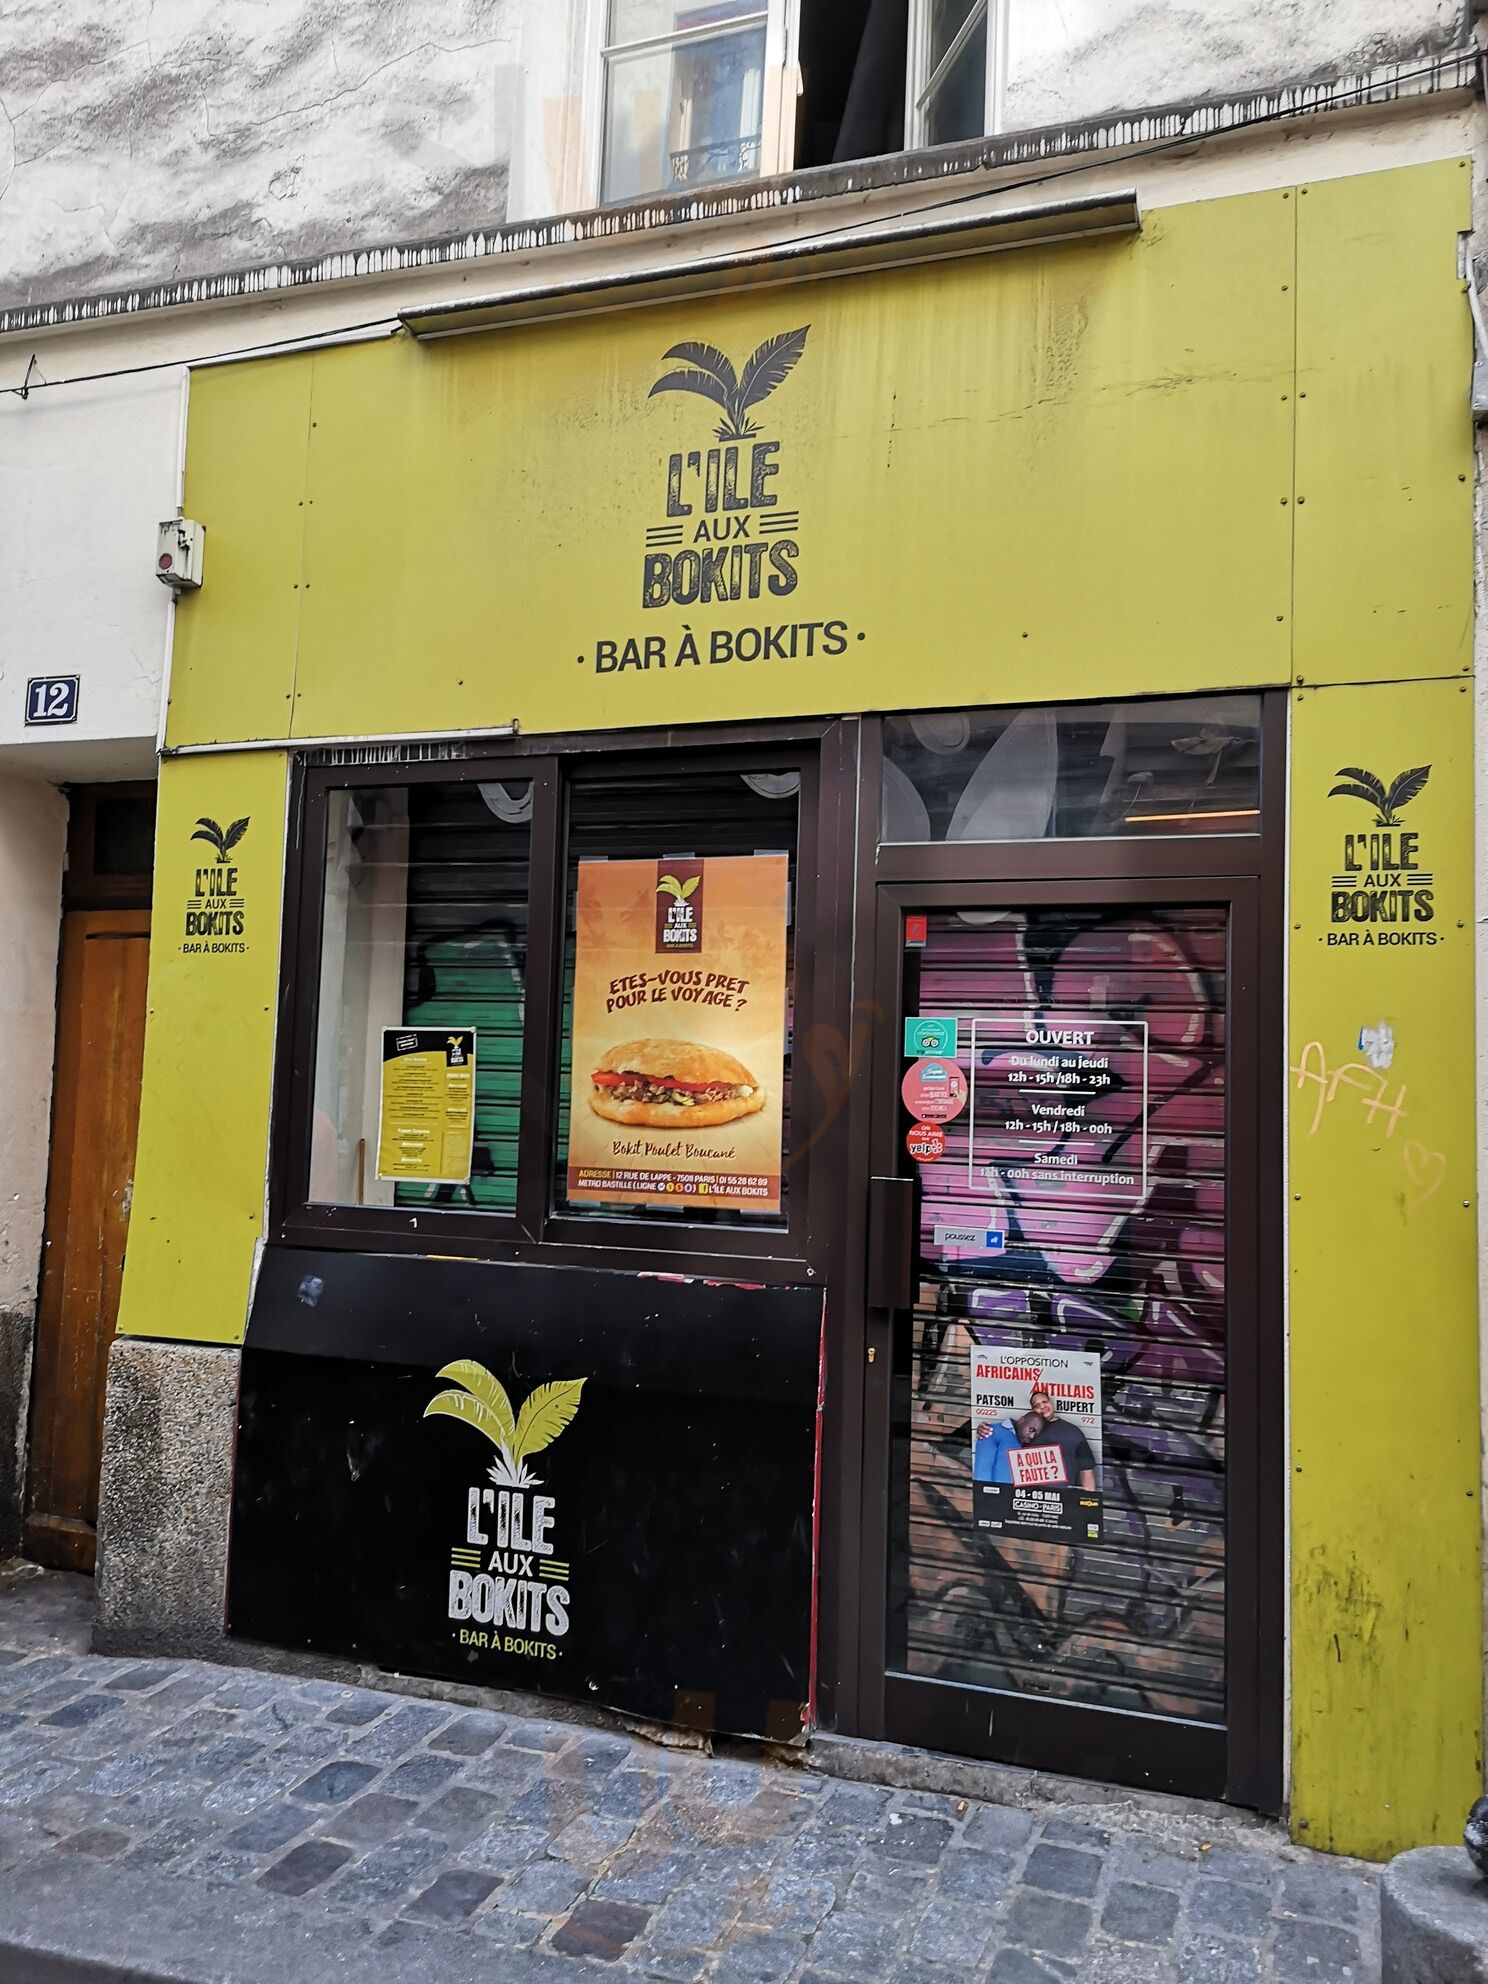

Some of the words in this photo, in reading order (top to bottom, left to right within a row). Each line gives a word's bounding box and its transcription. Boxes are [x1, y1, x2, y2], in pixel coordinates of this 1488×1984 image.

[666, 440, 780, 518] L'ILE
[693, 514, 750, 543] AUX
[642, 539, 799, 609] BOKITS
[595, 636, 666, 673] BAR
[674, 624, 700, 667] À
[710, 620, 847, 664] BOKITS
[32, 682, 69, 718] 12
[1344, 832, 1419, 872] L'ILE
[195, 867, 237, 898] L'ILE
[1363, 874, 1401, 888] AUX
[205, 898, 227, 909] AUX
[1331, 889, 1434, 924] BOKITS
[185, 911, 244, 936] BOKITS
[182, 943, 202, 954] BAR
[202, 940, 212, 954] À
[212, 942, 245, 954] BOKITS
[1327, 931, 1360, 947] BAR
[1362, 928, 1375, 946] À
[1378, 930, 1438, 946] BOKITS
[609, 970, 703, 995] ETES-VOUS
[705, 972, 750, 994] PRET
[606, 990, 647, 1014] POUR
[651, 987, 668, 1003] LE
[671, 986, 734, 1007] VOYAGE
[1025, 1030, 1095, 1046] OUVERT
[1029, 1056, 1059, 1067] lundi
[1061, 1058, 1076, 1067] au
[1078, 1057, 1109, 1069] jeudi
[1007, 1072, 1026, 1083] 12h
[1036, 1073, 1055, 1085] 15h
[1089, 1074, 1111, 1087] 23h
[1031, 1103, 1085, 1117] Vendredi
[1004, 1119, 1024, 1131] 12h
[1032, 1121, 1051, 1133] 15h
[1060, 1121, 1080, 1133] 18h
[1089, 1122, 1112, 1135] 00h
[612, 1141, 641, 1156] Bokit
[644, 1141, 683, 1157] Poulet
[685, 1143, 736, 1160] Boucané
[910, 1143, 932, 1154] yelp
[1034, 1153, 1078, 1166] Samedi
[578, 1169, 612, 1178] ADRESSE
[1007, 1168, 1029, 1179] 00h
[1031, 1171, 1058, 1180] sans
[1060, 1170, 1135, 1187] interruption
[1000, 1355, 1068, 1368] L'OPPOSITION
[976, 1394, 1014, 1407] PATSON
[1056, 1399, 1095, 1413] RUPERT
[1016, 1449, 1024, 1466] À
[1026, 1451, 1043, 1466] QUI
[1045, 1450, 1057, 1464] LA
[1020, 1468, 1050, 1483] FAUTE
[1015, 1489, 1026, 1498] 04
[466, 1486, 555, 1555] L'ILE
[487, 1551, 534, 1577] AUX
[448, 1569, 570, 1636] BOKITS
[459, 1629, 488, 1648] BAR
[490, 1630, 502, 1650] À
[503, 1635, 556, 1660] BOKITS
